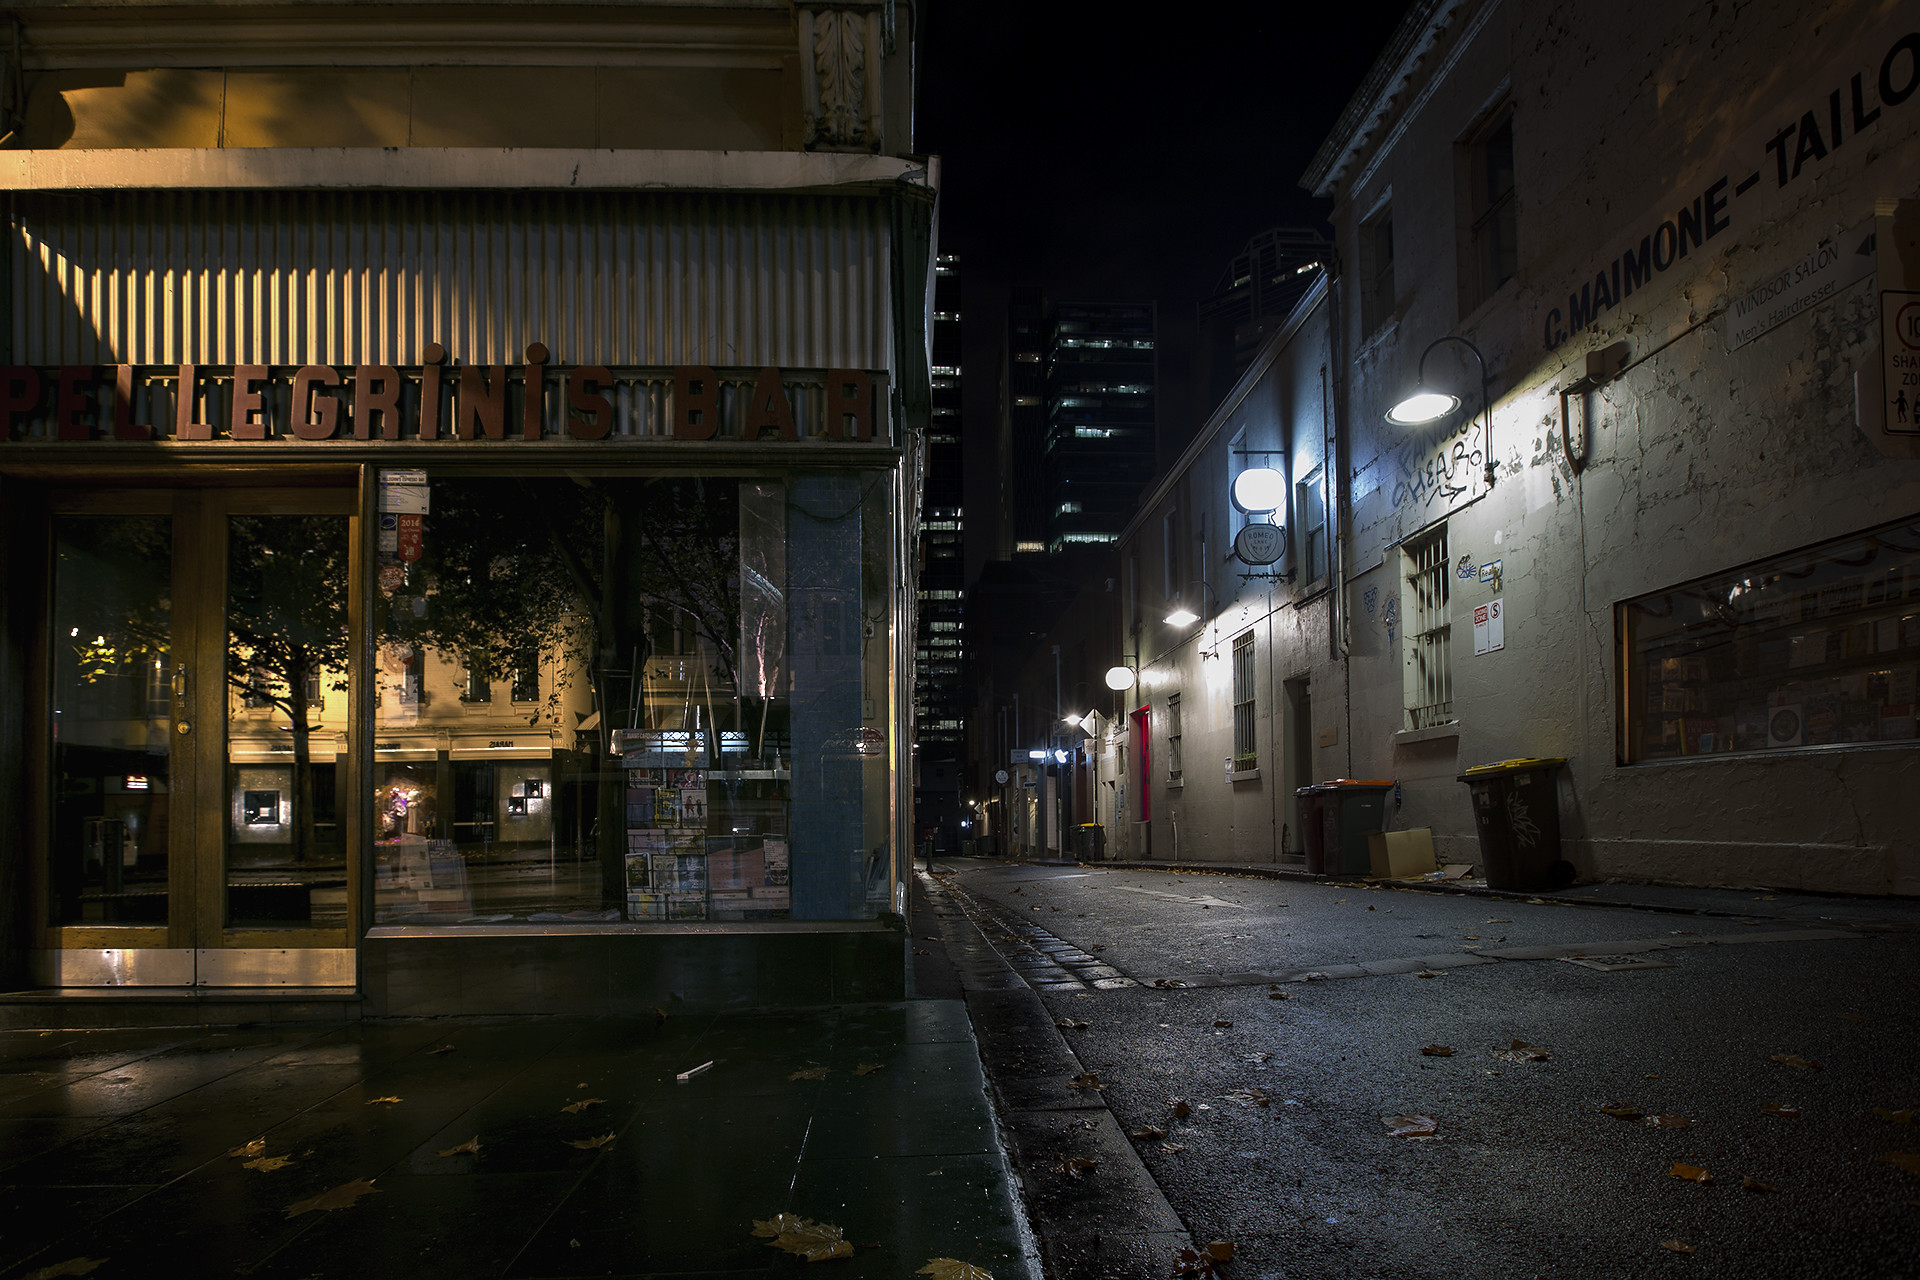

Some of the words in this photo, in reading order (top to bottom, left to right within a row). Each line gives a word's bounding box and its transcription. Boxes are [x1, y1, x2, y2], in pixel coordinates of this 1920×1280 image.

[1736, 272, 1792, 318] WINDSOR
[1795, 242, 1839, 284] SALON
[1735, 319, 1766, 345] Men's
[1768, 279, 1837, 327] Hairdresser
[1892, 354, 1920, 369] SHA
[1902, 372, 1920, 386] ZO
[673, 366, 873, 442] BAR
[1247, 532, 1274, 540] ROMEO
